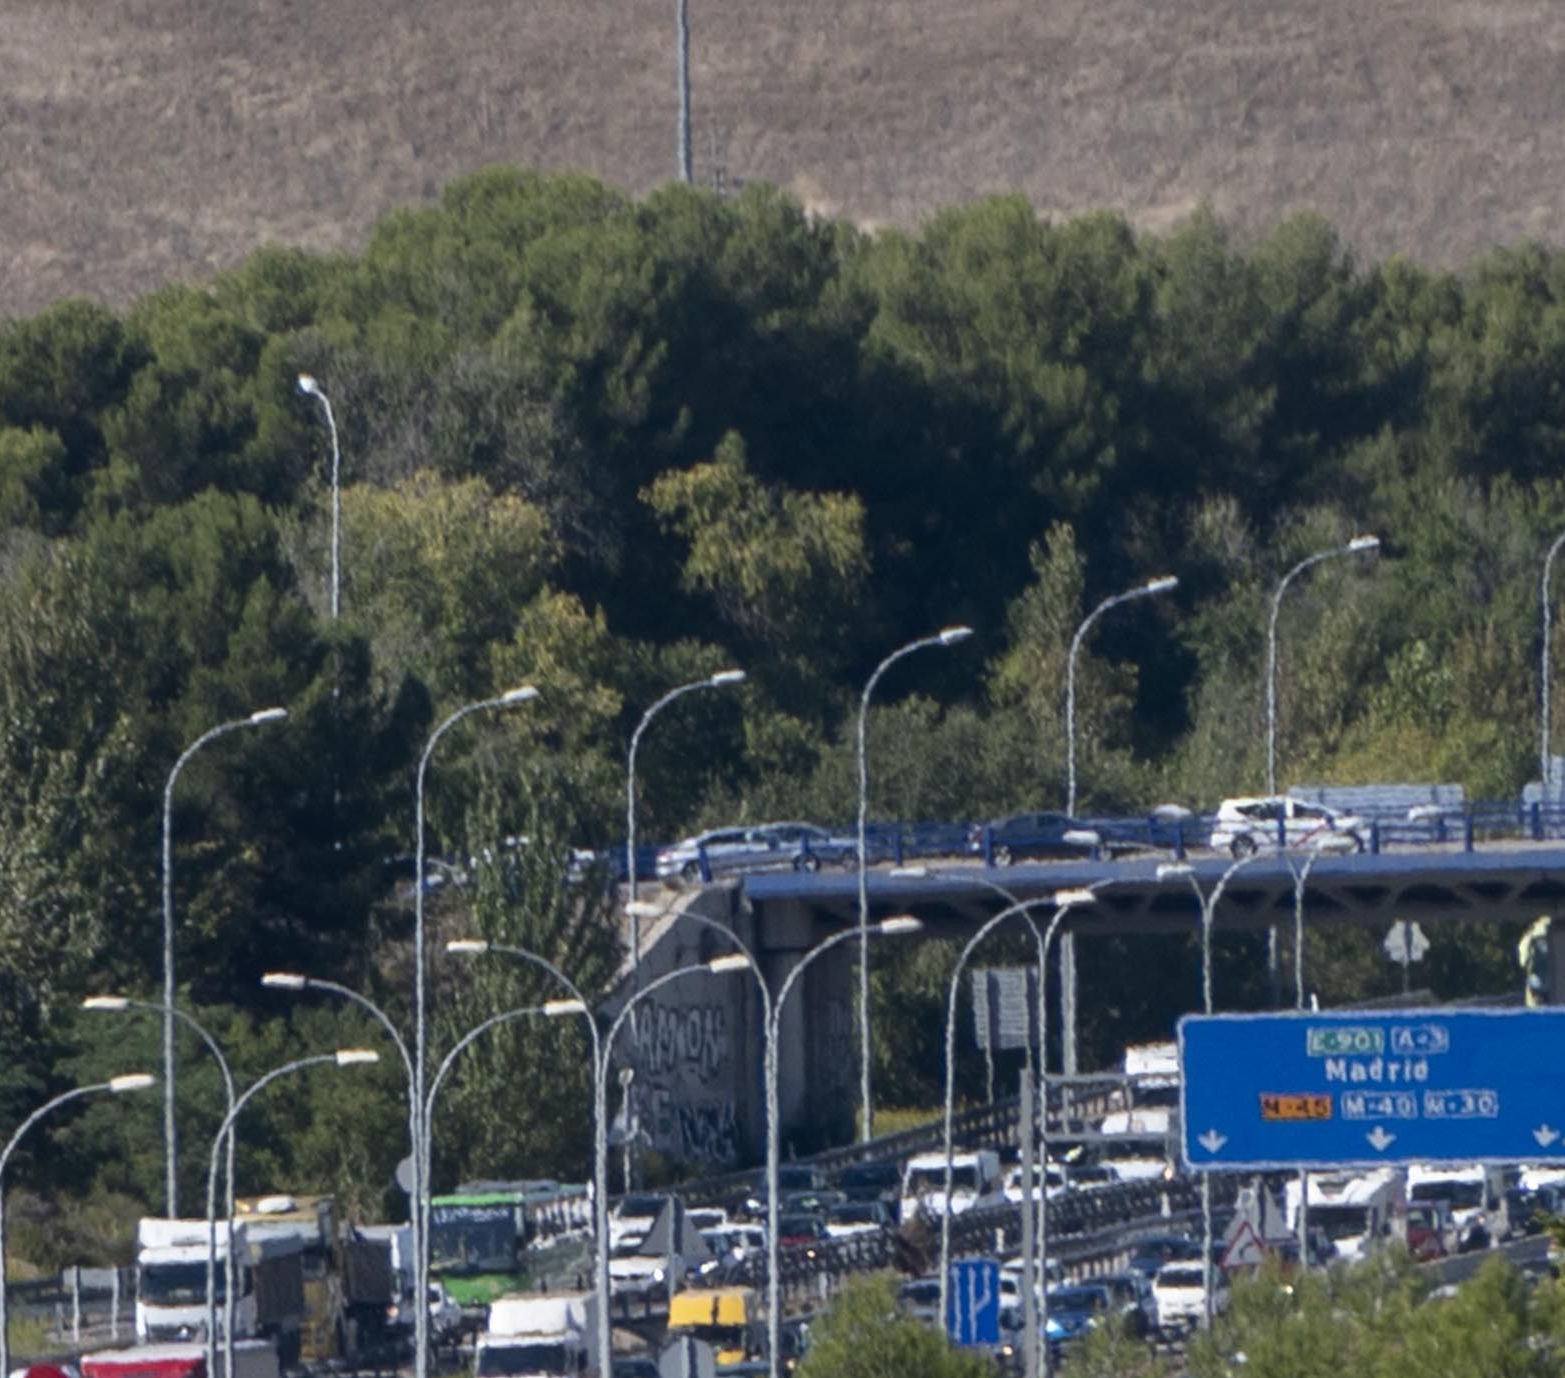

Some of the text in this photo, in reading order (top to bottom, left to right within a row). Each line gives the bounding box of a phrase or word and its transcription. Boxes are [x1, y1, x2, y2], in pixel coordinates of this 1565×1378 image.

[1312, 1027, 1446, 1051] E-901 A-3
[1325, 1056, 1429, 1083] Madrid
[1345, 1096, 1414, 1116] M-40
[1426, 1094, 1494, 1115] M-30
